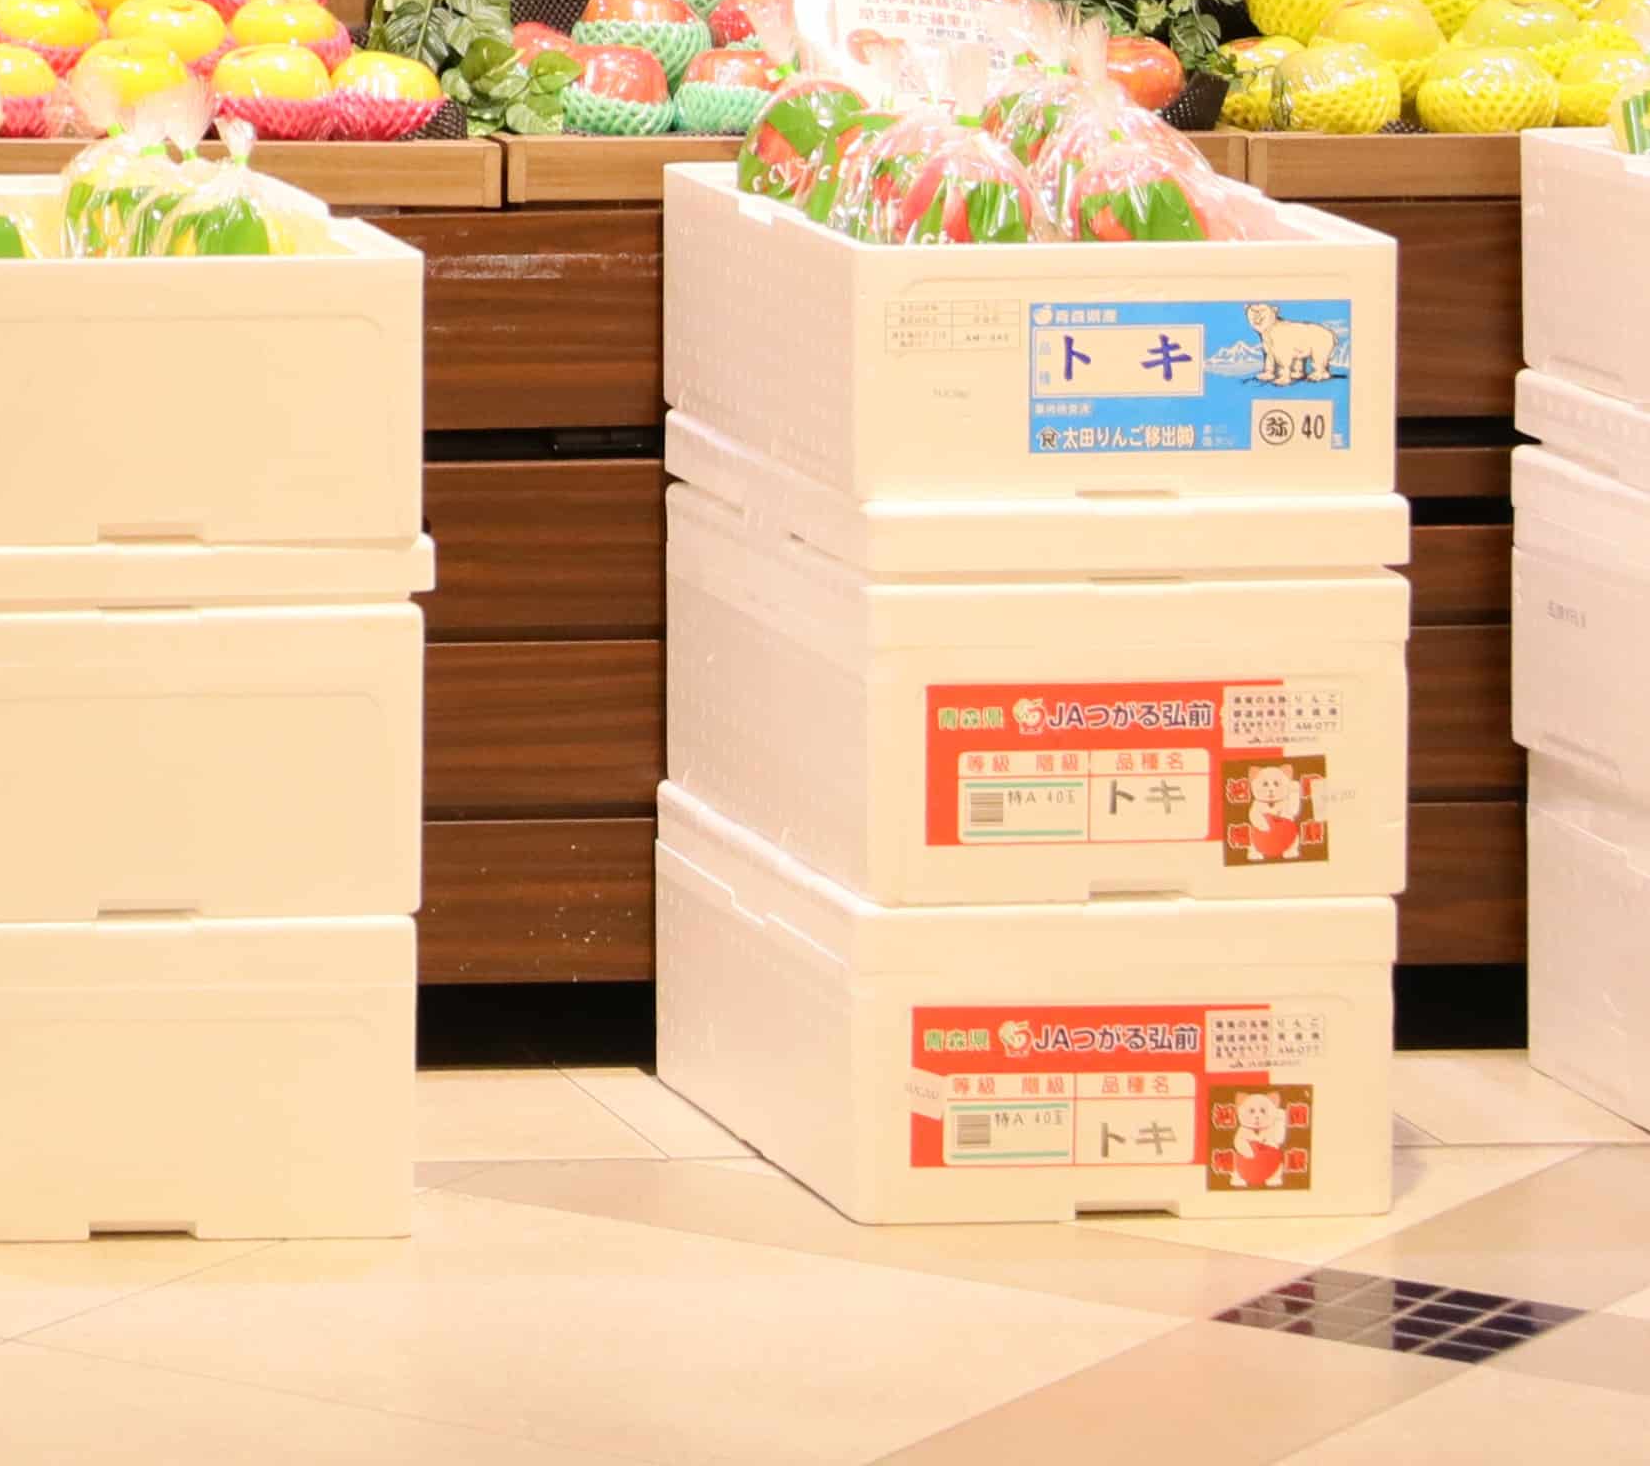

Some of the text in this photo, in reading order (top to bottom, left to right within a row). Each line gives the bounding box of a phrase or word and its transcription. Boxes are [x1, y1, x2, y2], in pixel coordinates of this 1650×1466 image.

[1300, 414, 1325, 440] 40
[1048, 701, 1214, 730] JAつがる弘前
[1034, 1024, 1200, 1053] JAつがる弘前
